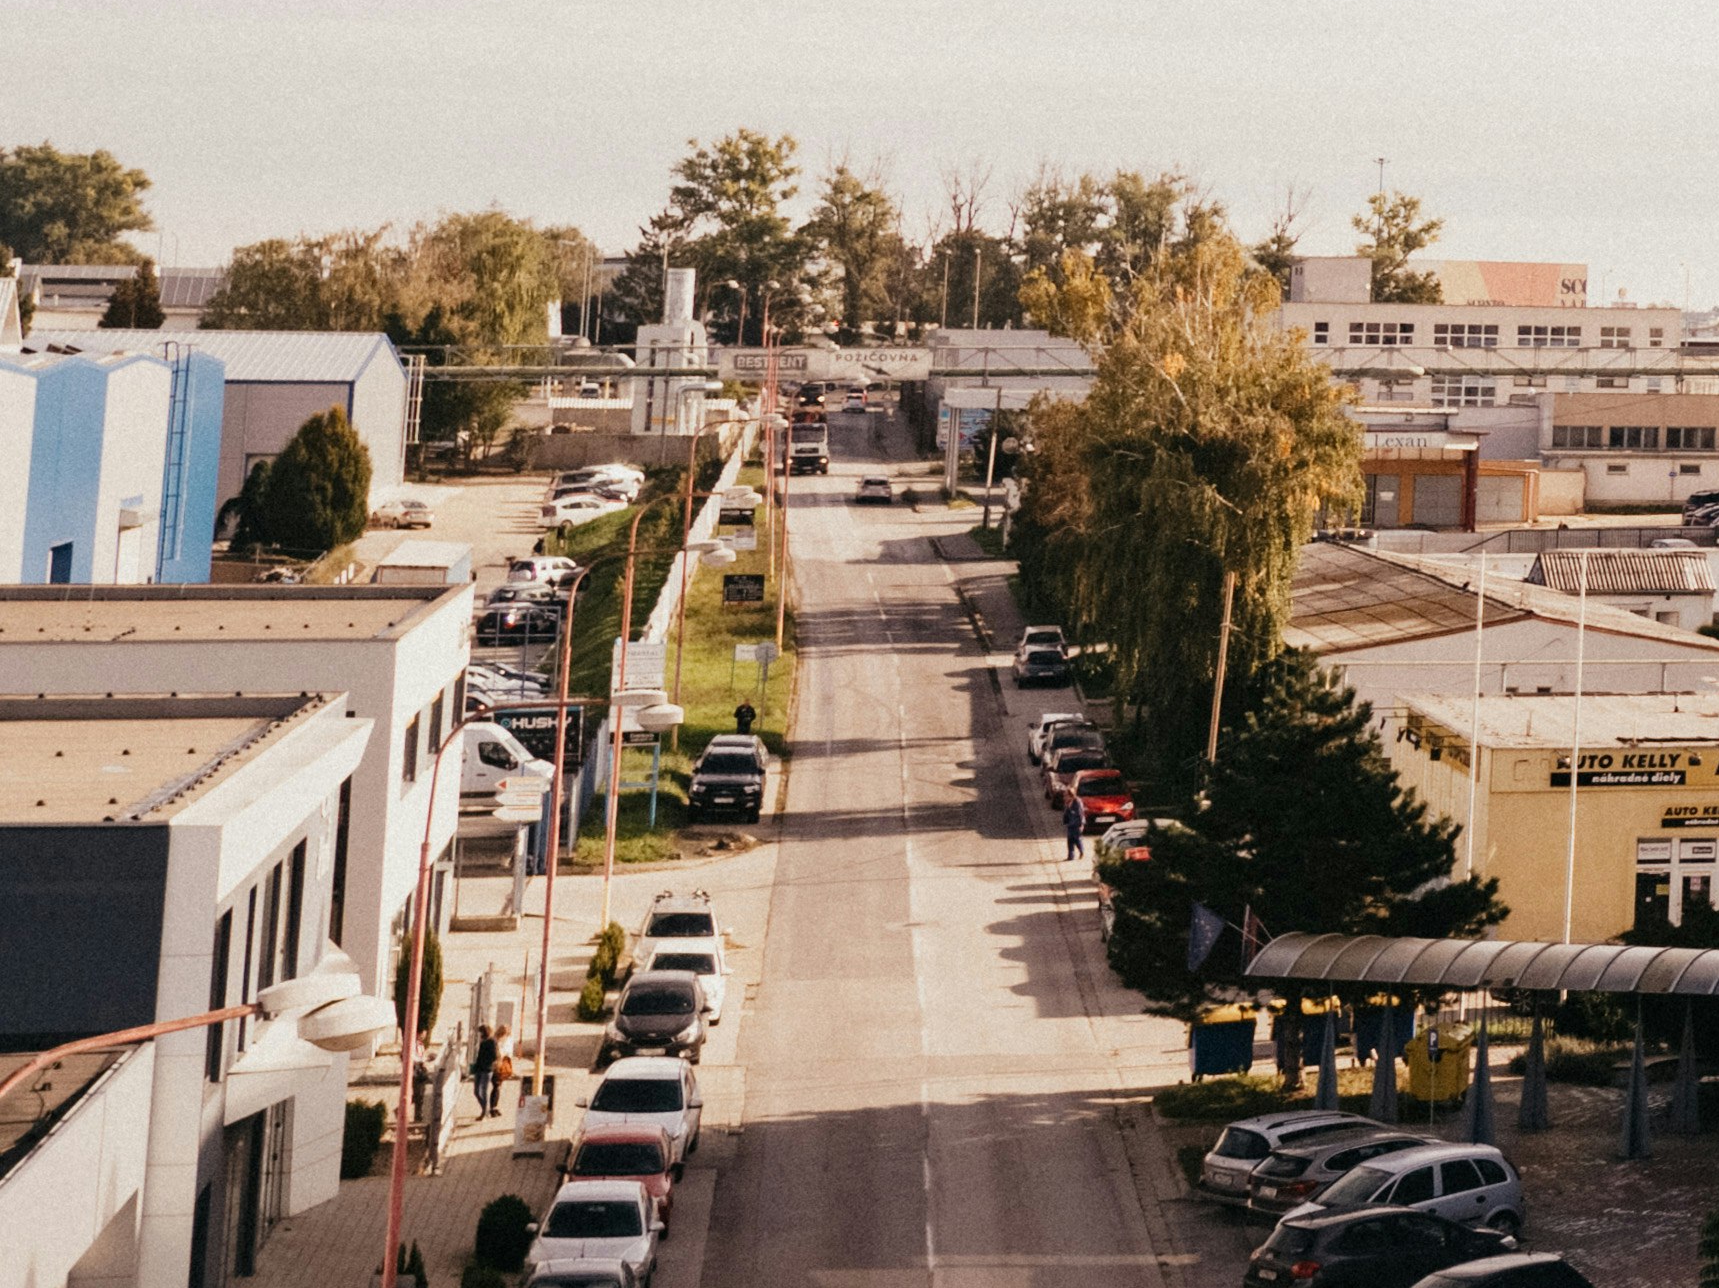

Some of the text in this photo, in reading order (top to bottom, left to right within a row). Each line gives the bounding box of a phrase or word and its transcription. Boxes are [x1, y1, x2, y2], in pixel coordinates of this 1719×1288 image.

[735, 357, 806, 370] BESTENT
[1374, 433, 1428, 448] Lexan
[1622, 753, 1682, 769] KELLY
[1591, 771, 1682, 785] náhradné diely
[1664, 806, 1699, 817] AUTO
